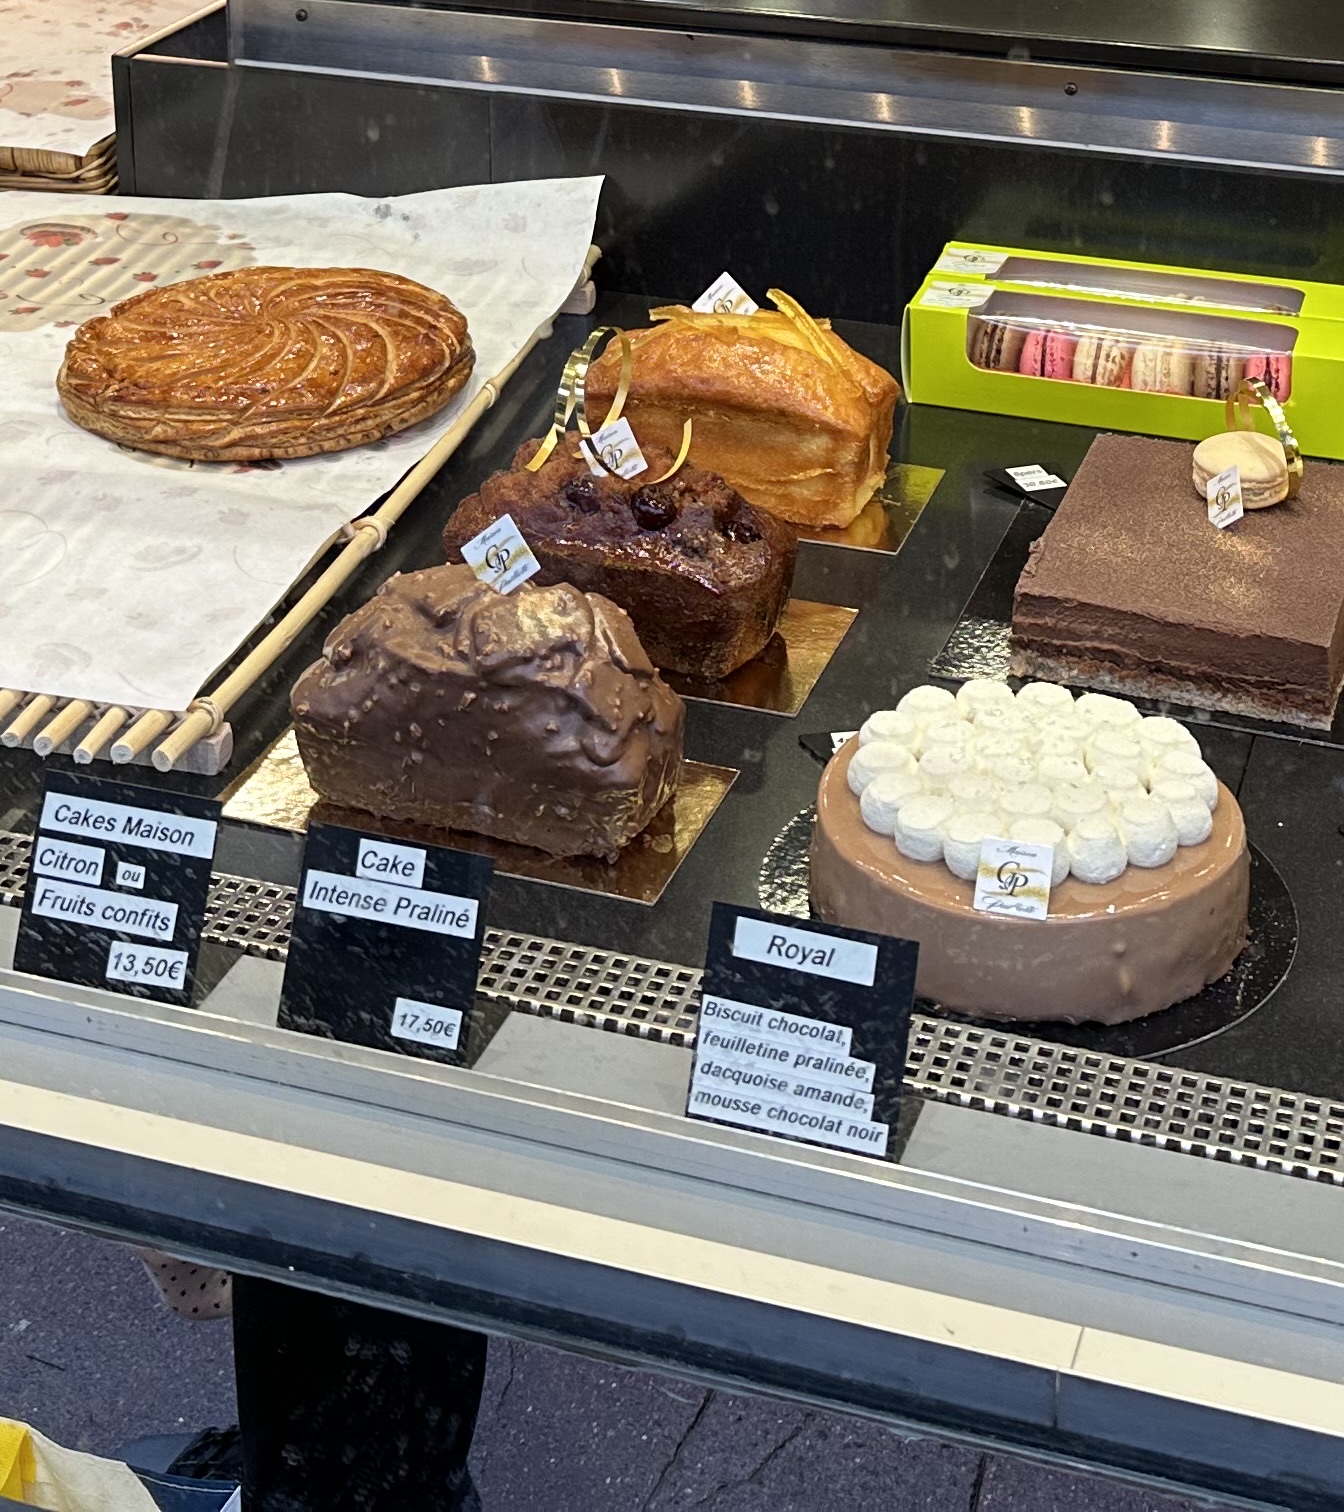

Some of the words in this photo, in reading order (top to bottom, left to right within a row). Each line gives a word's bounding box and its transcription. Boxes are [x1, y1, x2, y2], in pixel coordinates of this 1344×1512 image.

[53, 804, 119, 833] Cakes
[122, 817, 196, 847] Maison
[38, 848, 99, 877] Citron
[121, 869, 141, 884] ou
[360, 849, 416, 878] Cake
[38, 888, 97, 918] Fruits
[101, 903, 172, 932] confits
[308, 880, 387, 914] Intense
[392, 897, 471, 930] Praliné
[111, 951, 184, 981] 13,50€
[765, 935, 836, 969] Royal
[399, 1012, 455, 1038] 17,50€
[703, 1001, 763, 1026] Biscuit
[767, 1014, 846, 1046] chocolat,
[702, 1029, 789, 1063] feuilletine
[793, 1051, 870, 1084] pralinée,
[700, 1059, 789, 1097] dacquoise
[793, 1083, 869, 1114] amande,
[694, 1092, 762, 1117] mousse
[766, 1105, 842, 1134] chocolat
[846, 1119, 884, 1143] noir
